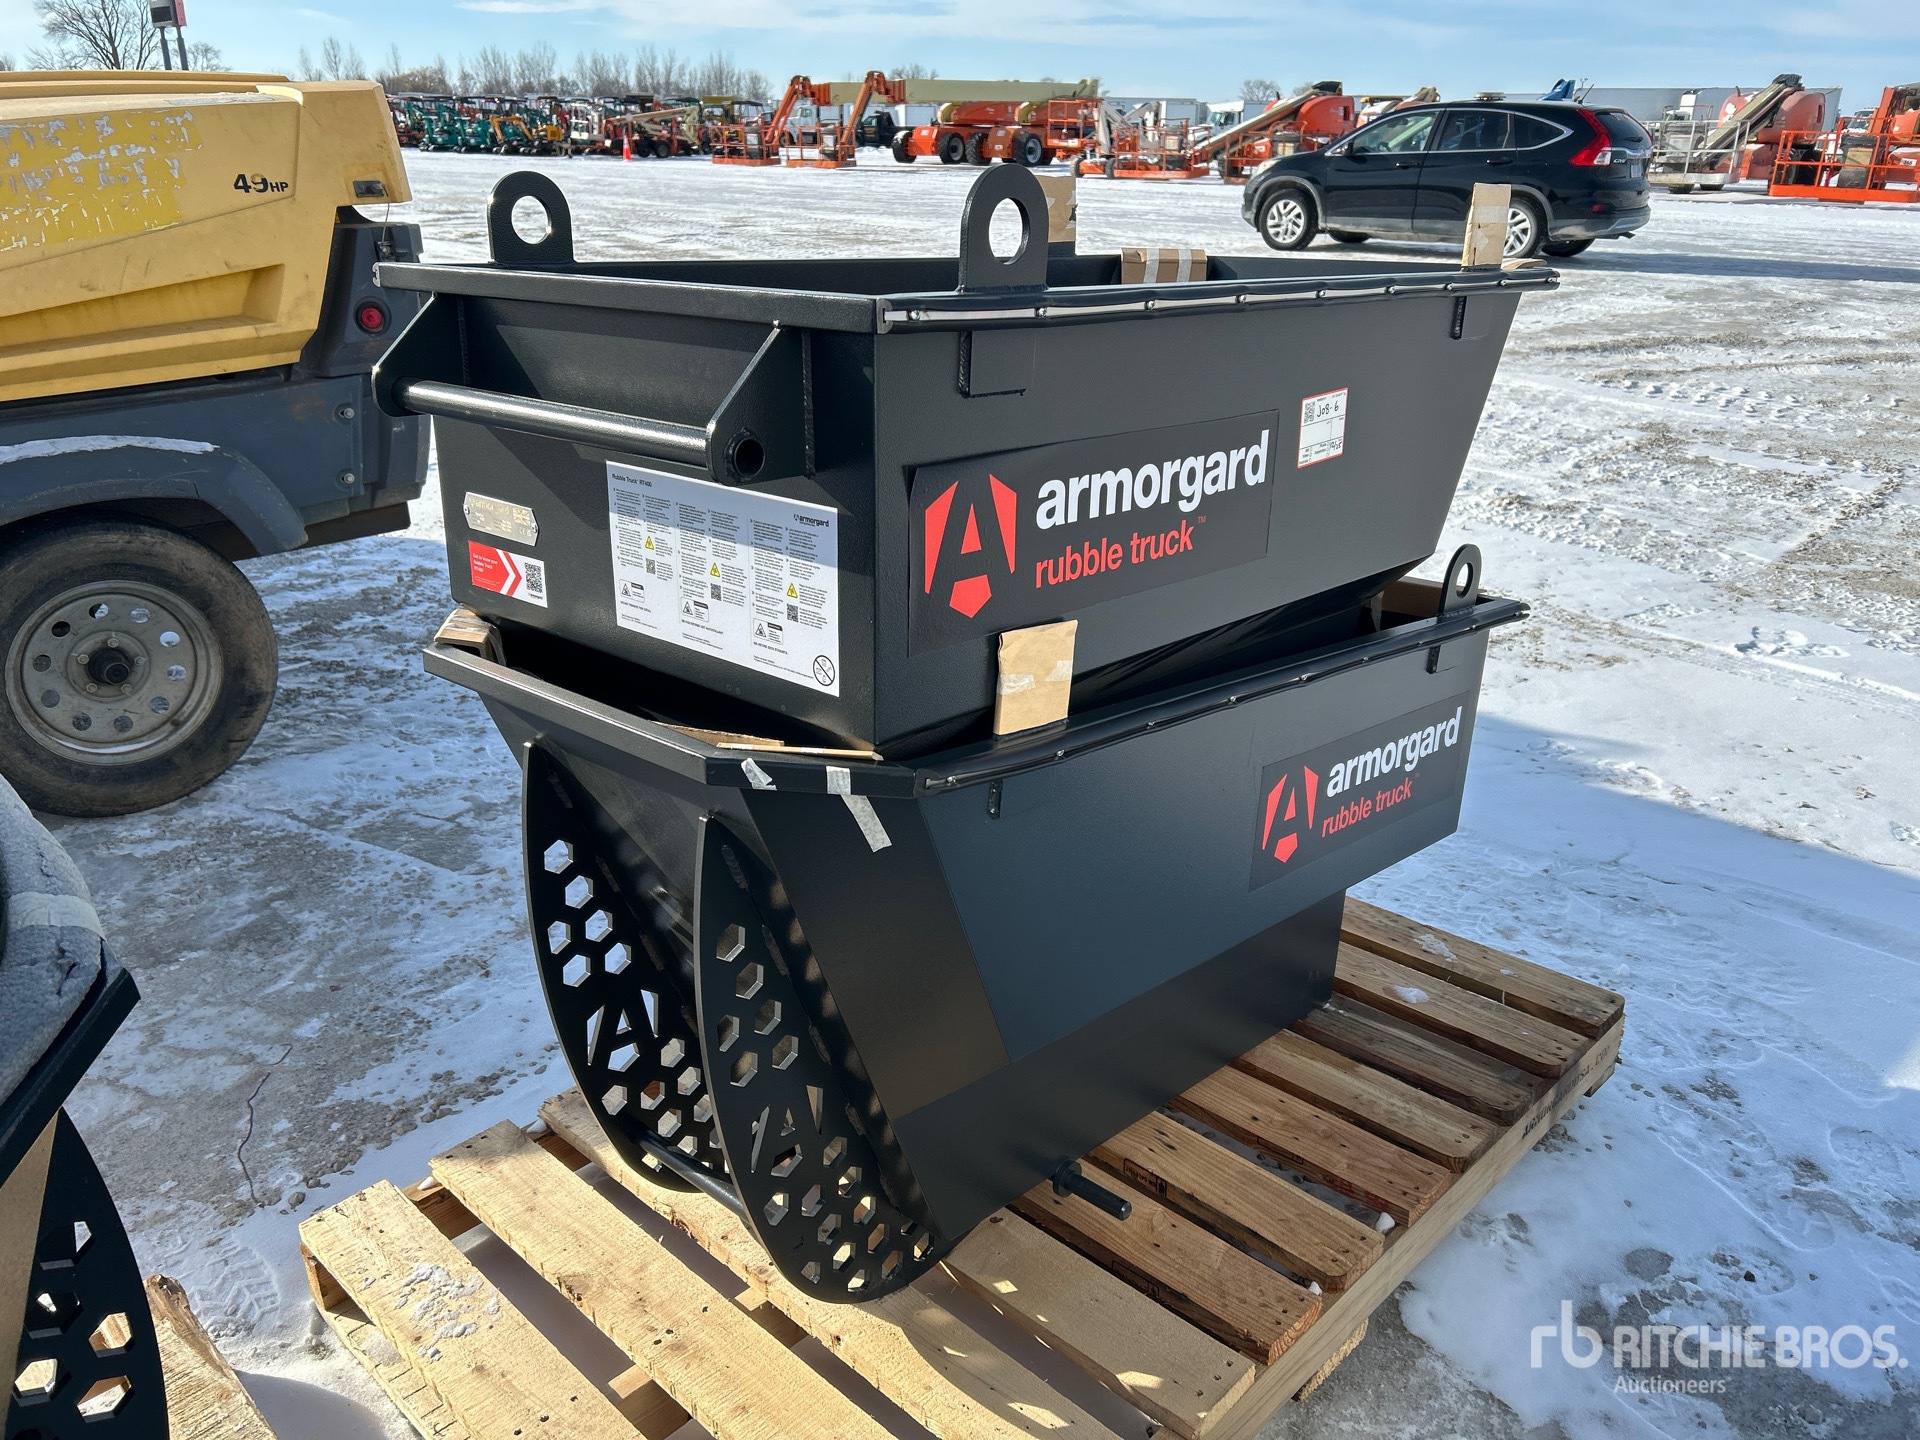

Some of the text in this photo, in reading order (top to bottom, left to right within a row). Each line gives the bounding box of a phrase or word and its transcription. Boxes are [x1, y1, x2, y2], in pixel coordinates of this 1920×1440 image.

[612, 473, 626, 482] Rubble
[626, 476, 638, 485] Truck
[1036, 429, 1270, 530] armorgard
[799, 515, 830, 528] armorgard
[1035, 539, 1123, 589] rubble
[1130, 520, 1195, 565] truck
[1326, 706, 1463, 798] armorgard
[1321, 777, 1413, 838] rubble truck
